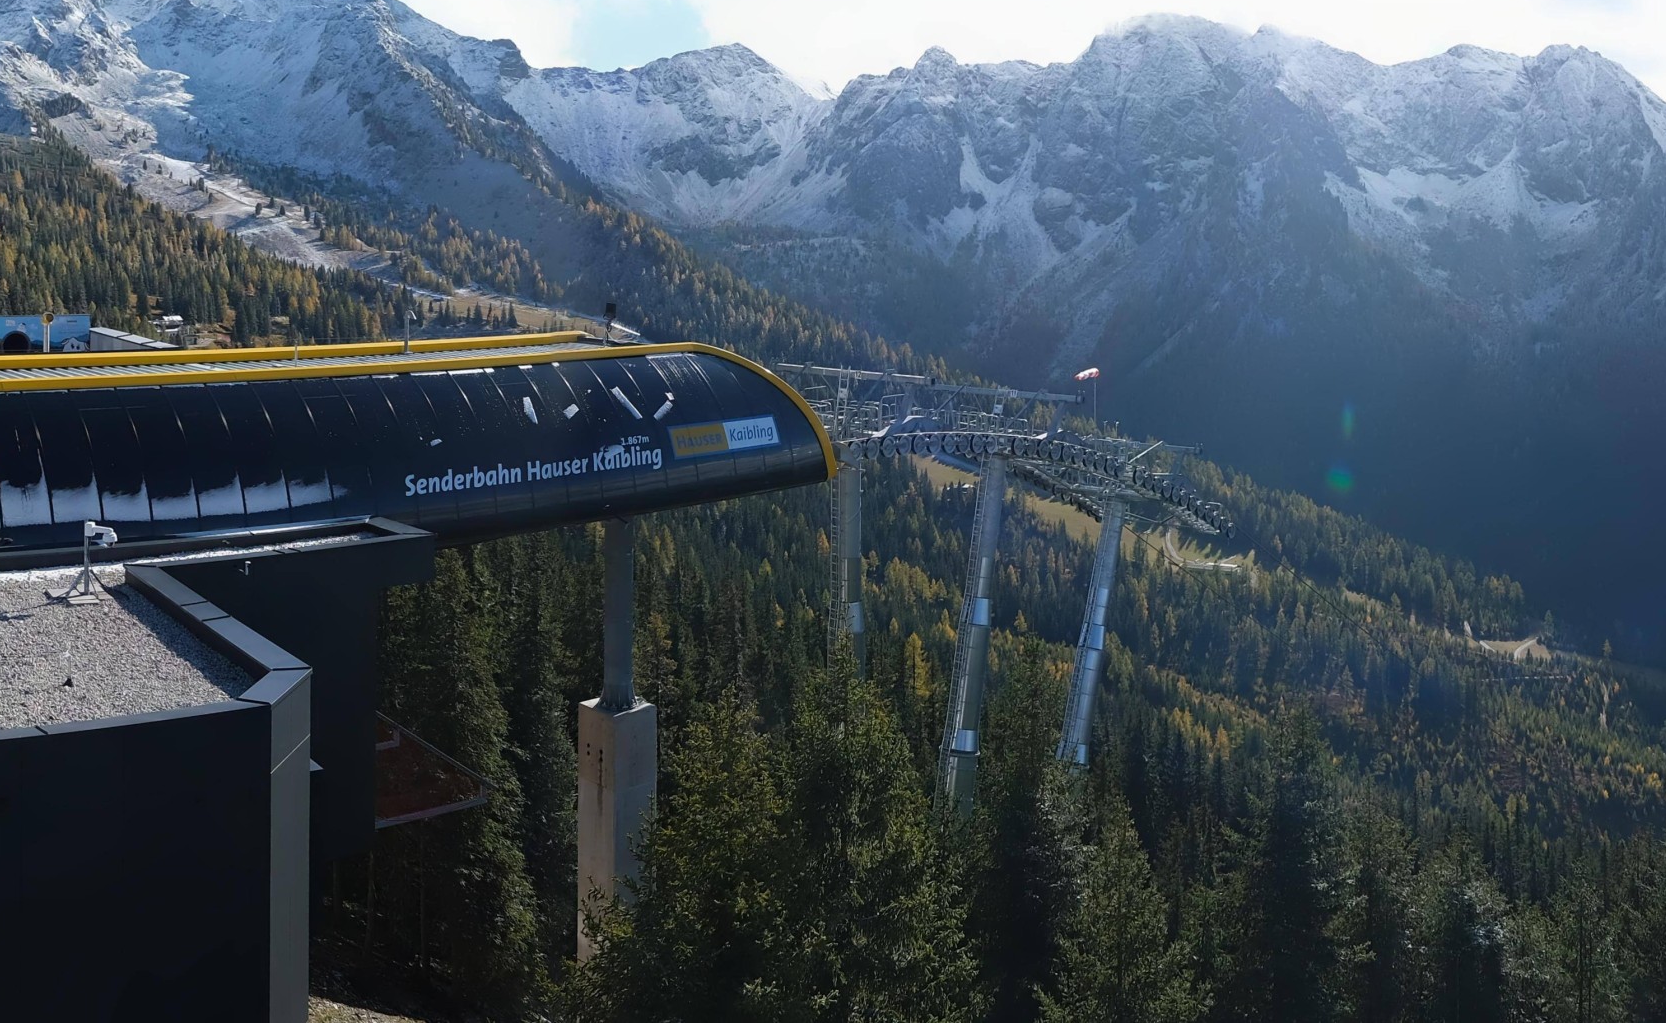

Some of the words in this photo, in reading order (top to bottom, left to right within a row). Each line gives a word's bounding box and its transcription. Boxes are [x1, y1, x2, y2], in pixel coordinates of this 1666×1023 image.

[676, 433, 722, 449] HAUSER
[729, 425, 774, 442] Kaibling
[405, 463, 522, 497] Senderbahn
[527, 458, 589, 481] Hauser
[592, 446, 662, 470] Kaibling
